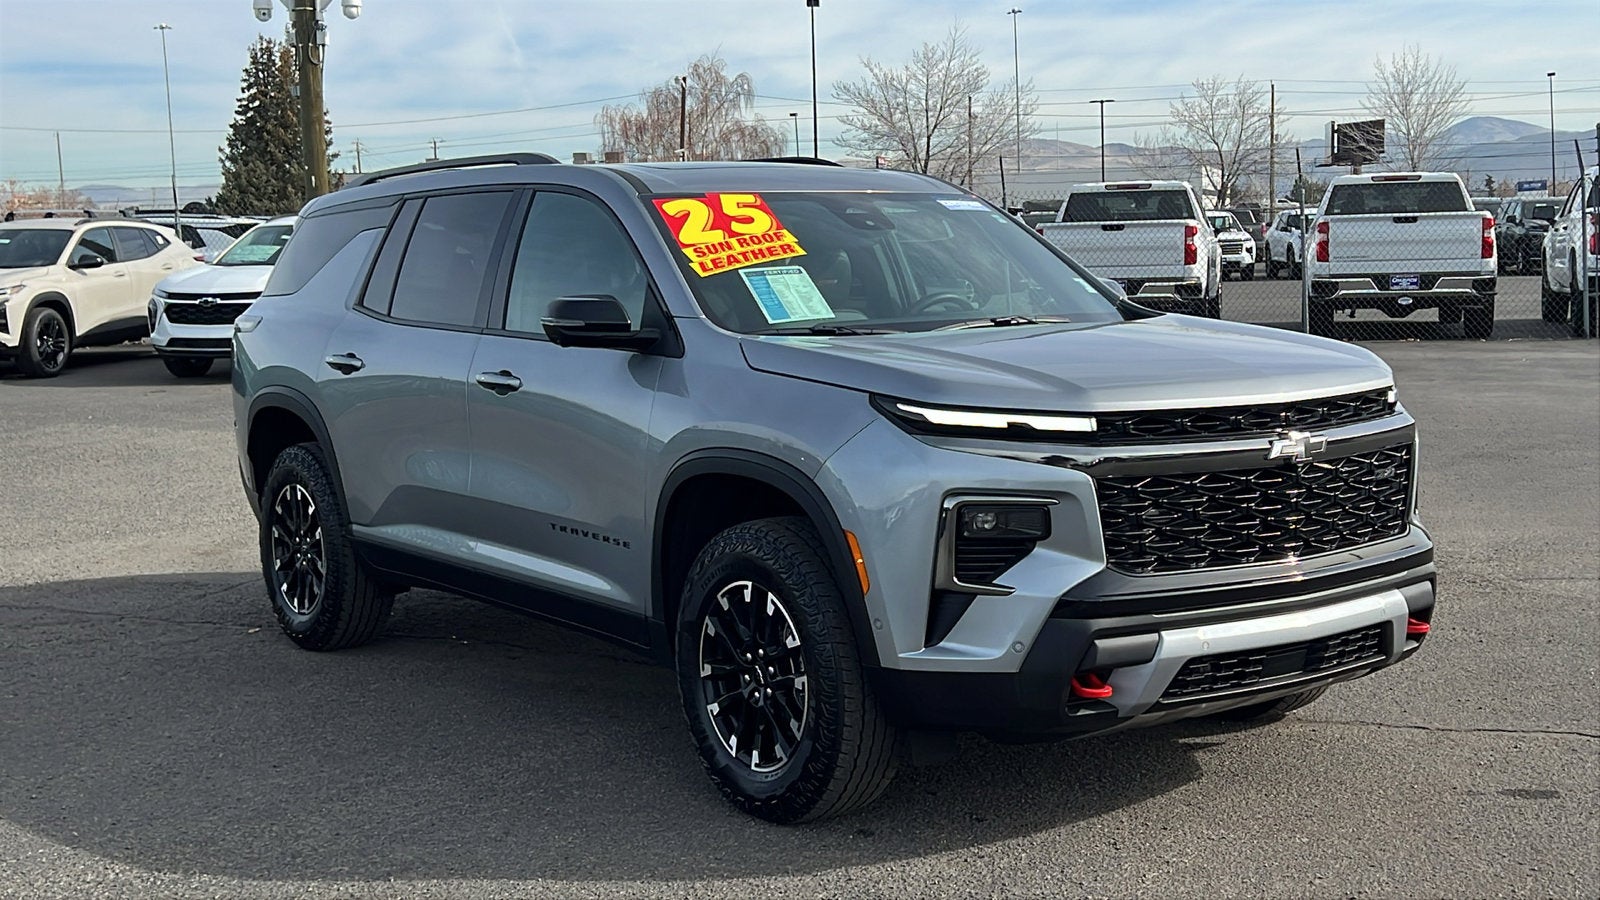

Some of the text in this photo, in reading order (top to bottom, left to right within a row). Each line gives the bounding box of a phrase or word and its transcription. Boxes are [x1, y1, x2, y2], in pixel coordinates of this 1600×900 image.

[661, 194, 776, 245] 25
[693, 231, 787, 258] SUN ROOF
[699, 243, 797, 273] LEATHER
[550, 522, 631, 550] TRAVERSE
